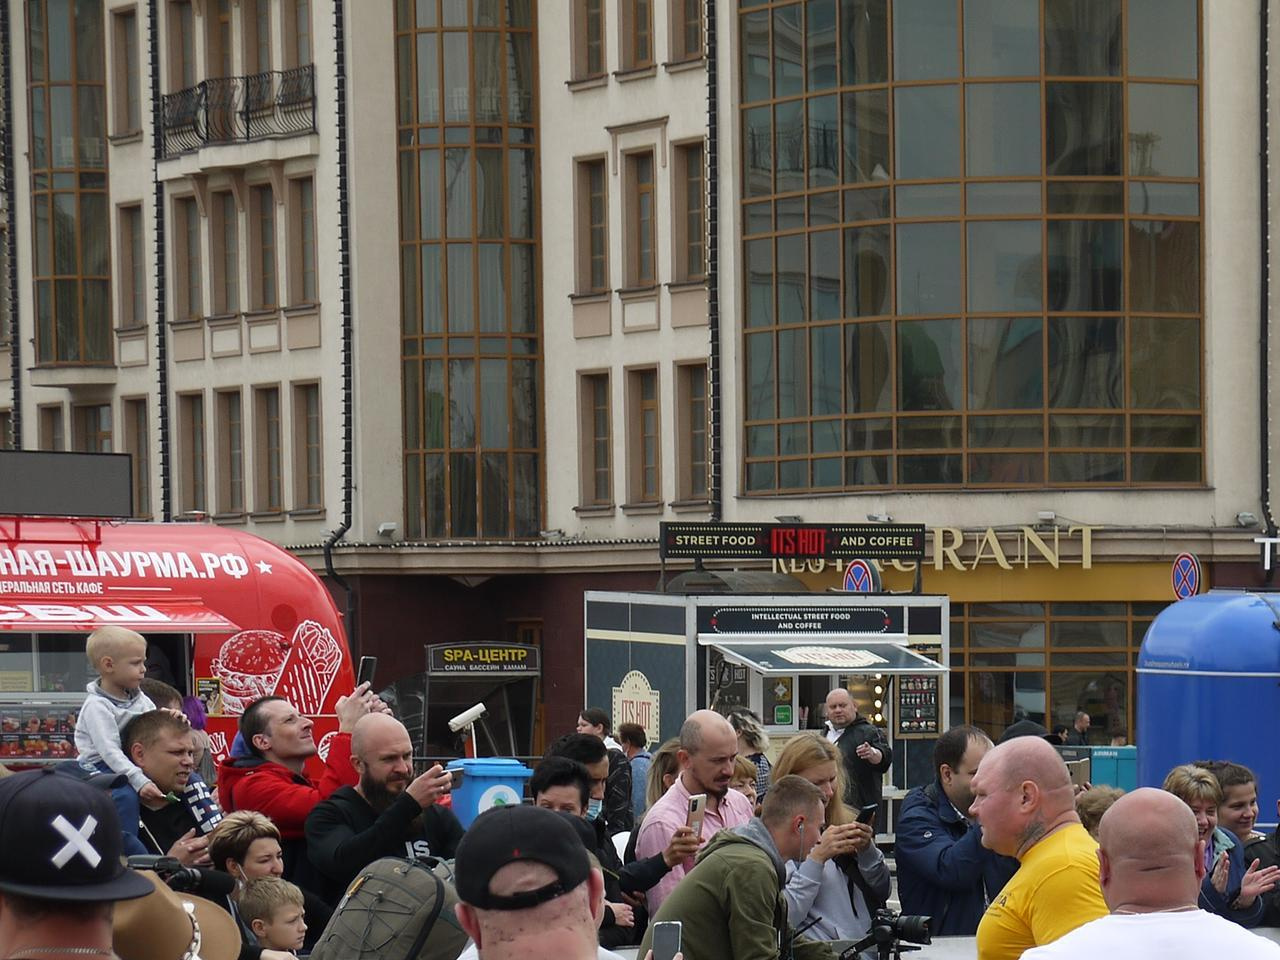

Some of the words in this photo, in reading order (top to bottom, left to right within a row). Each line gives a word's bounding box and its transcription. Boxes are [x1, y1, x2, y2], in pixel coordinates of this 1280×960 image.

[675, 535, 719, 546] STREET
[721, 535, 756, 546] FOOD
[799, 528, 827, 555] HOT
[841, 536, 866, 546] AND
[869, 536, 914, 546] COFFEE
[52, 582, 75, 594] СЕТЬ
[76, 582, 104, 594] КАФЕ
[443, 649, 528, 663] SPA-ЦЕНТР
